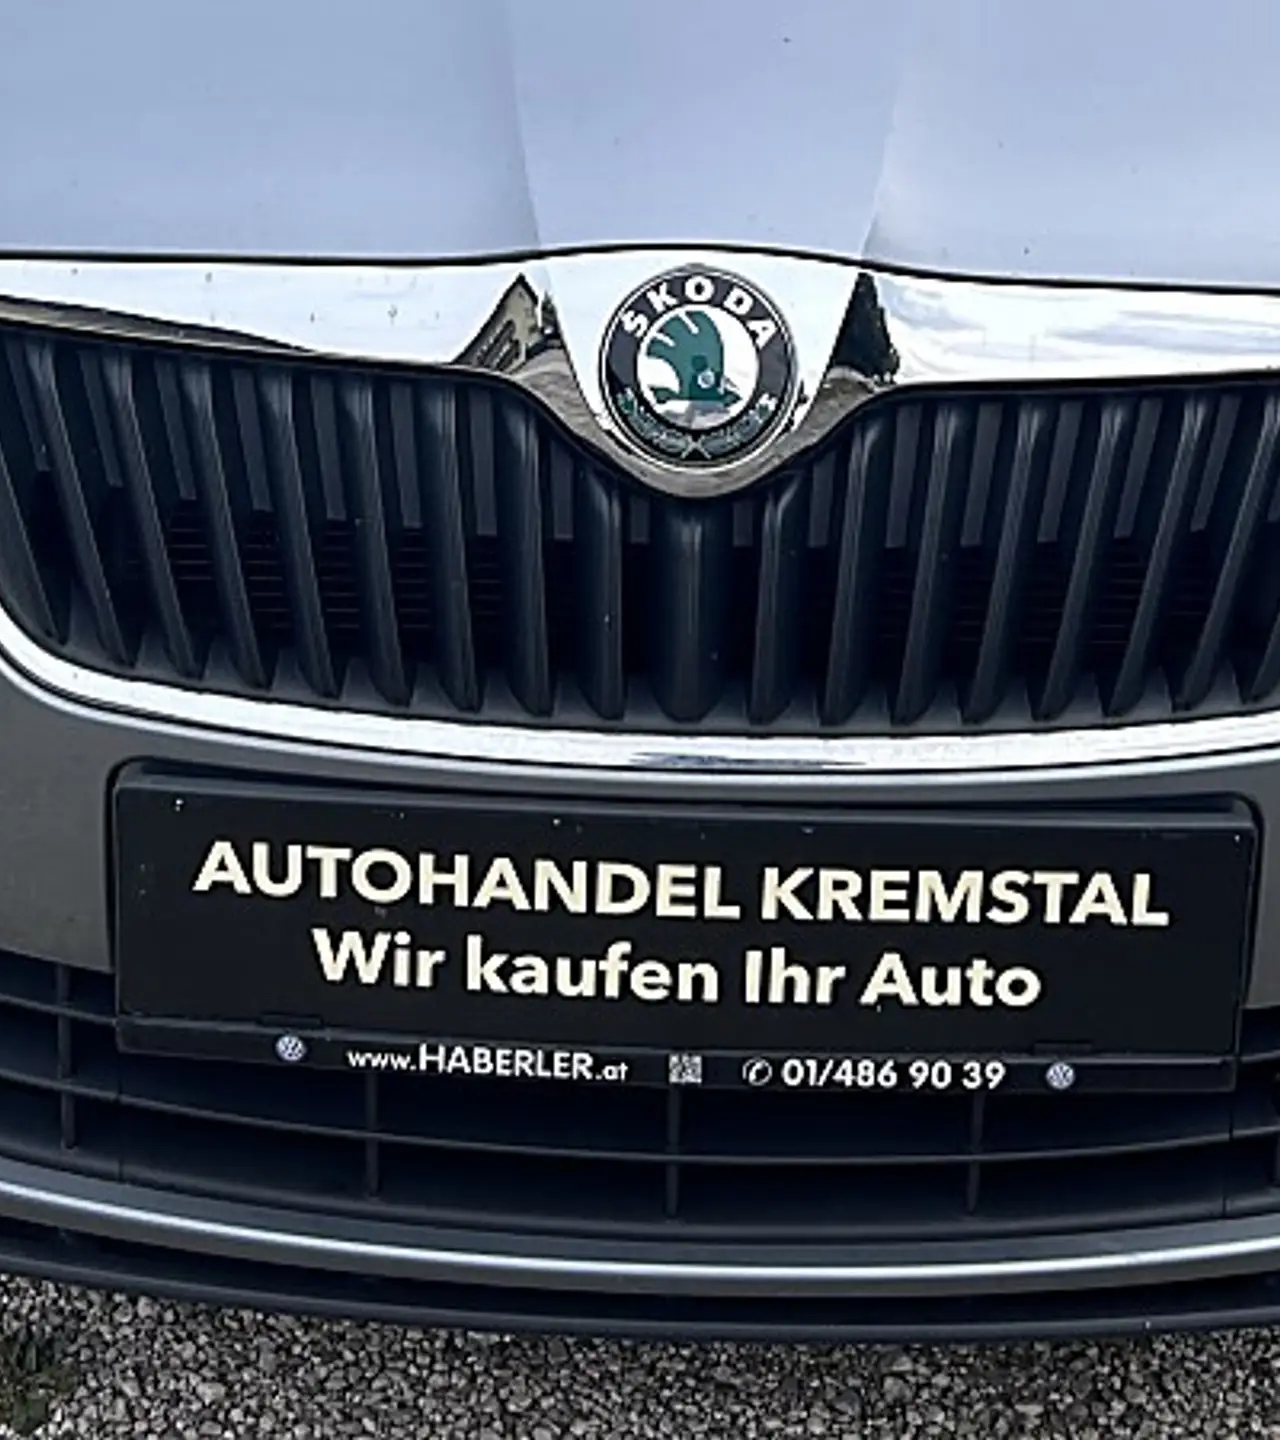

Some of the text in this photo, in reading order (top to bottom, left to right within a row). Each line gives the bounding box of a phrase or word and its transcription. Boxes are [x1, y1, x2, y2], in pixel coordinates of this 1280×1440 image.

[192, 840, 1170, 926] AUTOHANDEL KREMSTAL
[311, 927, 1043, 1007] Wir kaufen Ihr Auto
[346, 1043, 1007, 1090] www.HABERLER.at 01/486 90 39
